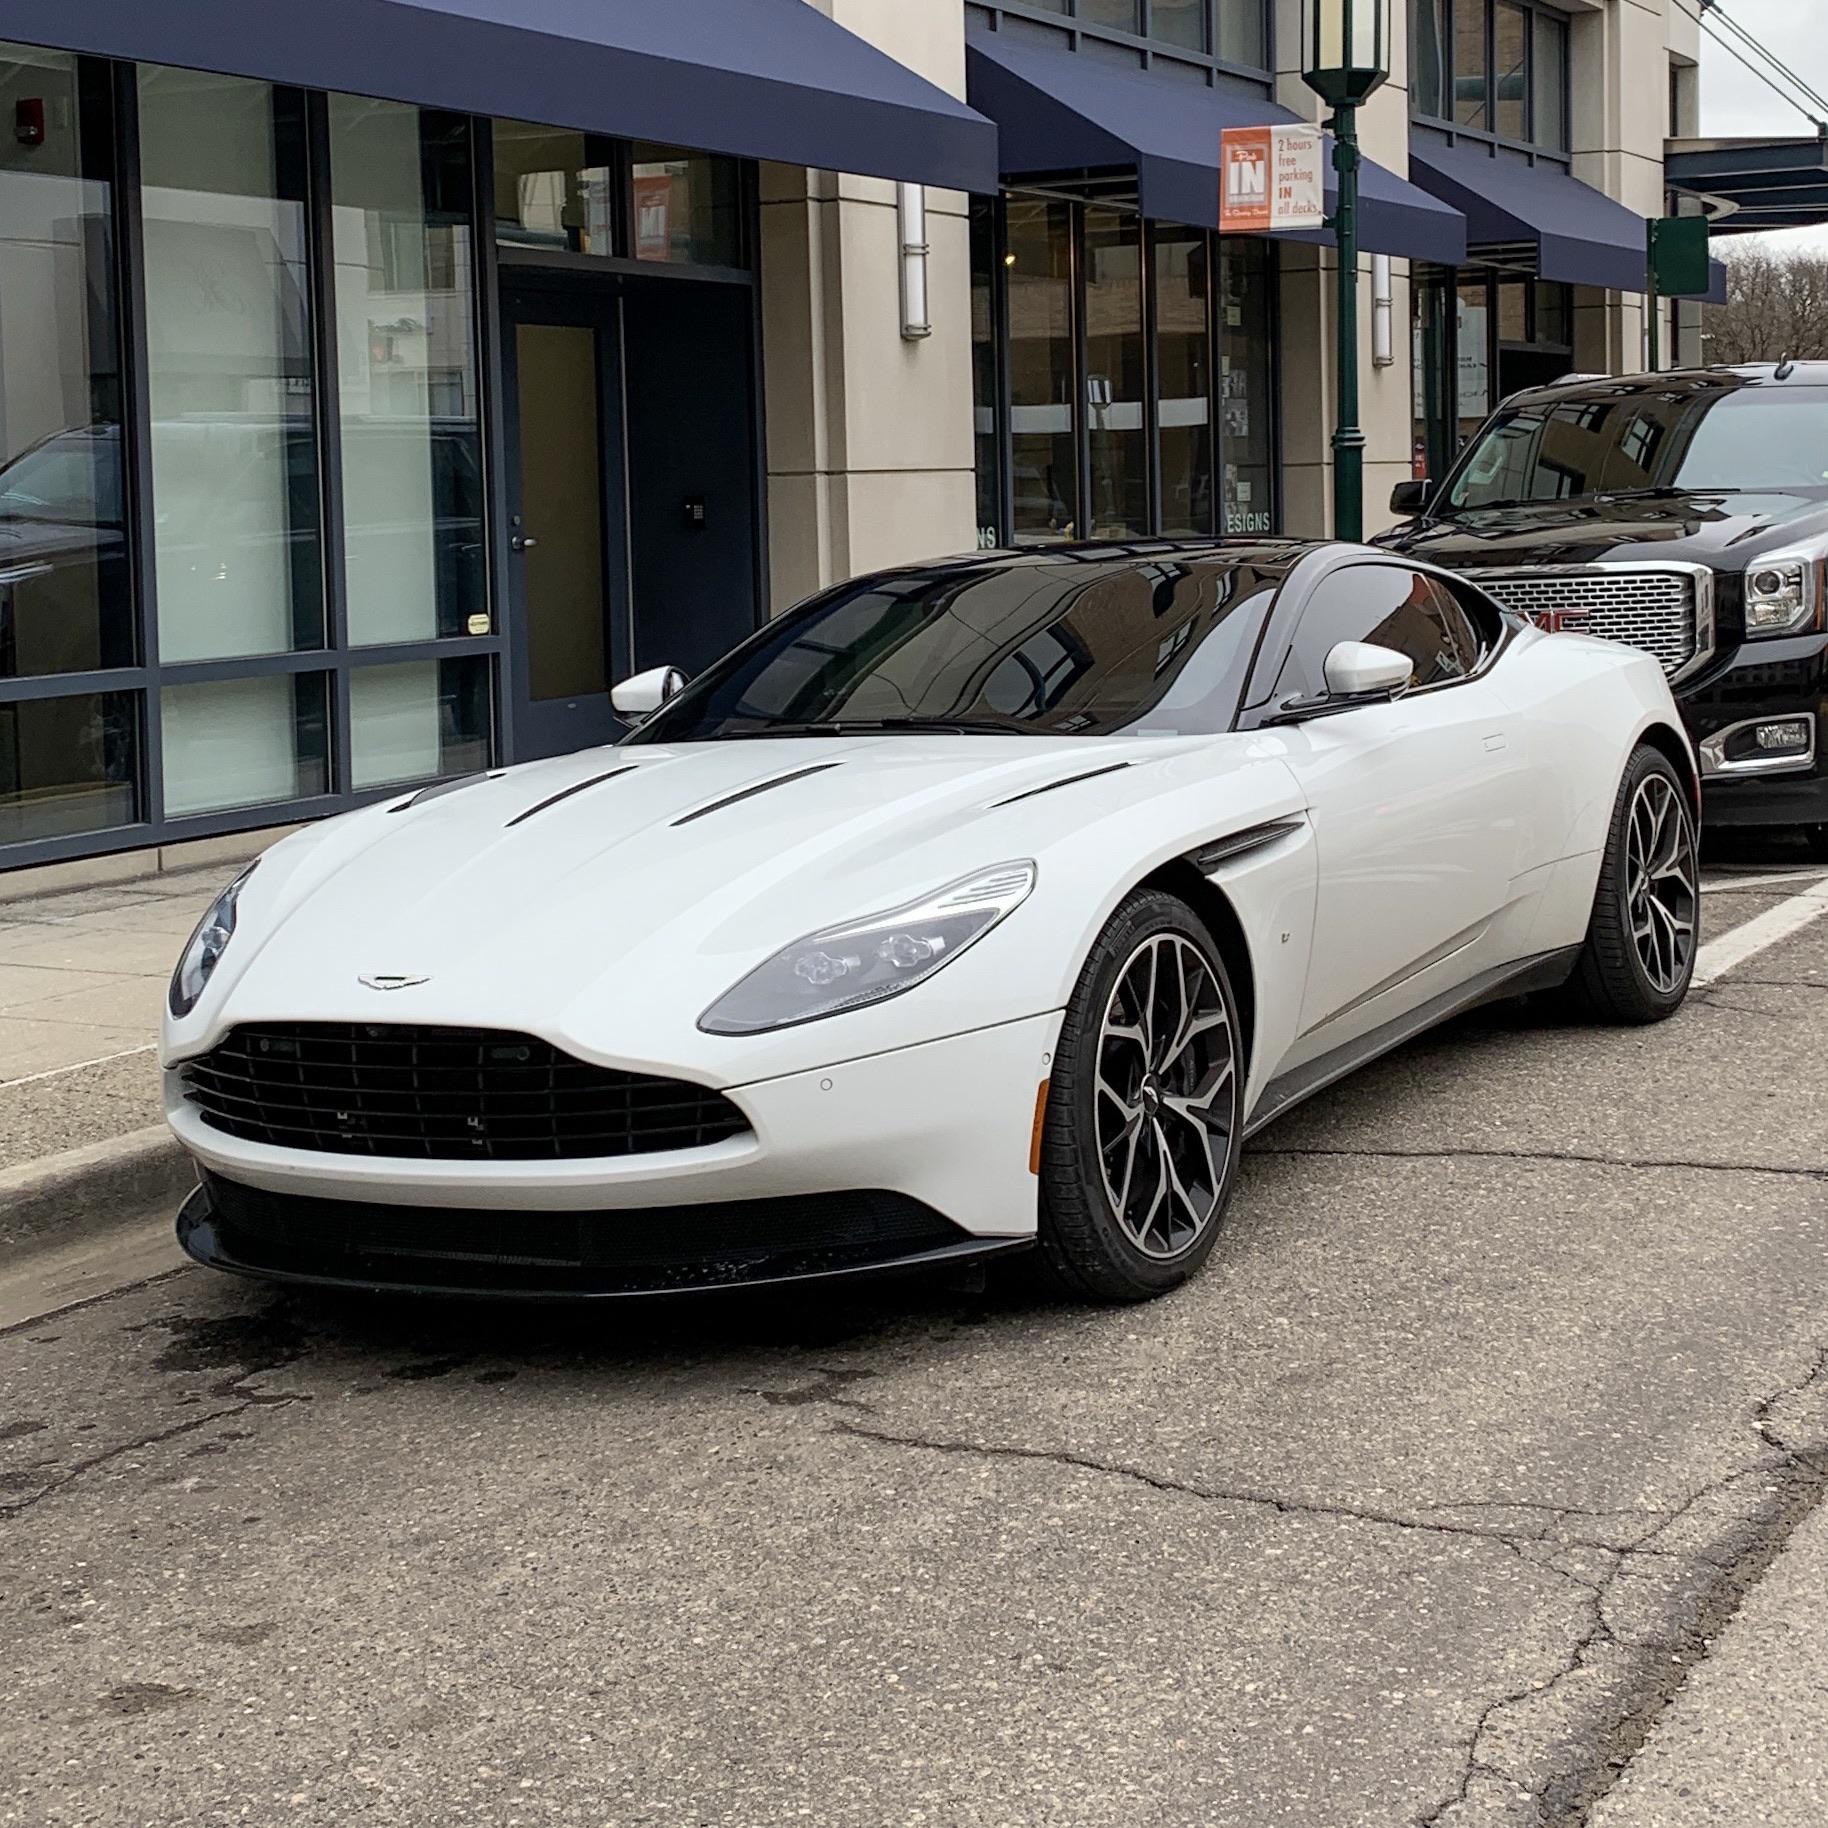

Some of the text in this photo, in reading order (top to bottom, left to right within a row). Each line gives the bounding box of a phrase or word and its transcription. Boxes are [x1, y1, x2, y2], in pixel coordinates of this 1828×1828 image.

[1278, 137, 1312, 152] 2 hours
[1278, 153, 1297, 167] free
[1229, 160, 1265, 195] IN
[1278, 167, 1313, 184] parking
[1279, 186, 1292, 199] IN
[1278, 201, 1290, 215] all
[1226, 511, 1270, 533] ESIGNS
[976, 526, 996, 549] NS
